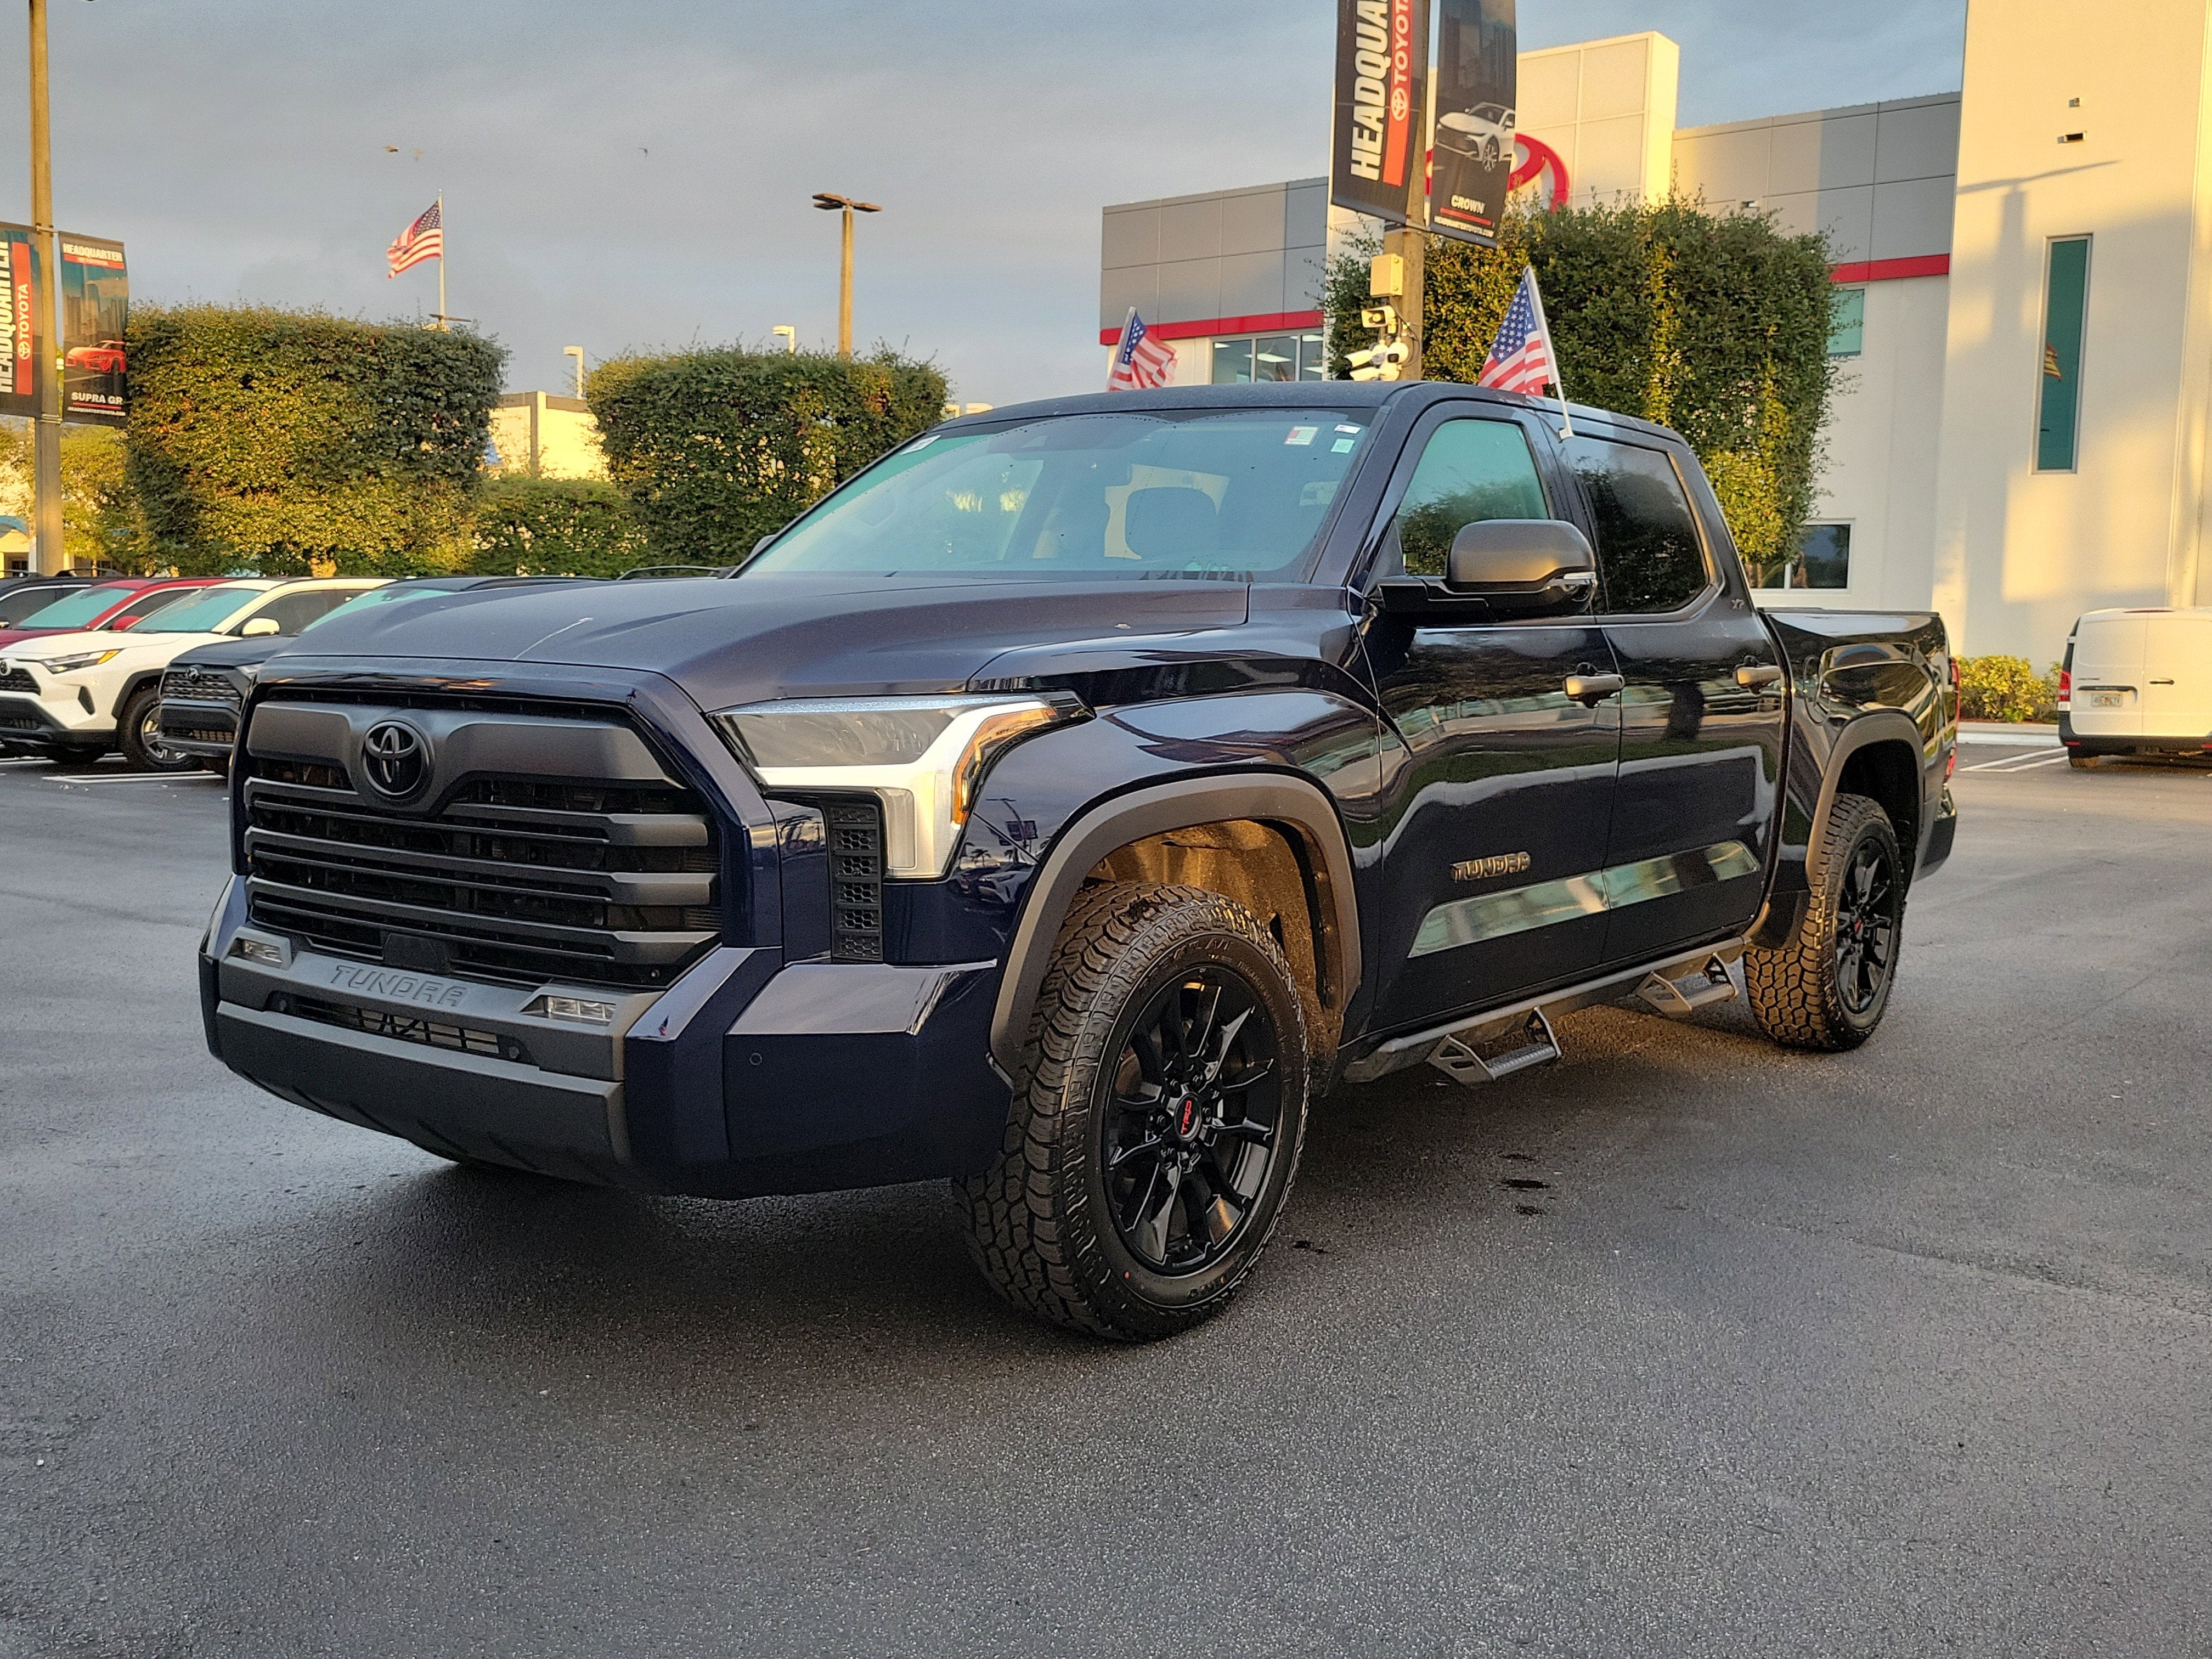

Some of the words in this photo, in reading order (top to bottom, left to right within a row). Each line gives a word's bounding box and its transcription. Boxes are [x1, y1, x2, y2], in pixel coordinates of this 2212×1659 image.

[1393, 0, 1410, 86] TOYOT
[1350, 0, 1392, 181] HEADQUA
[1451, 194, 1486, 215] CROWN
[63, 242, 123, 262] HEADQUARTER
[18, 283, 30, 340] TOYOTA
[71, 391, 106, 404] SUPRA
[107, 395, 123, 405] GR
[1450, 851, 1531, 883] TUNDRA
[330, 964, 468, 1007] TUNDRA
[1180, 1100, 1192, 1135] TRD
